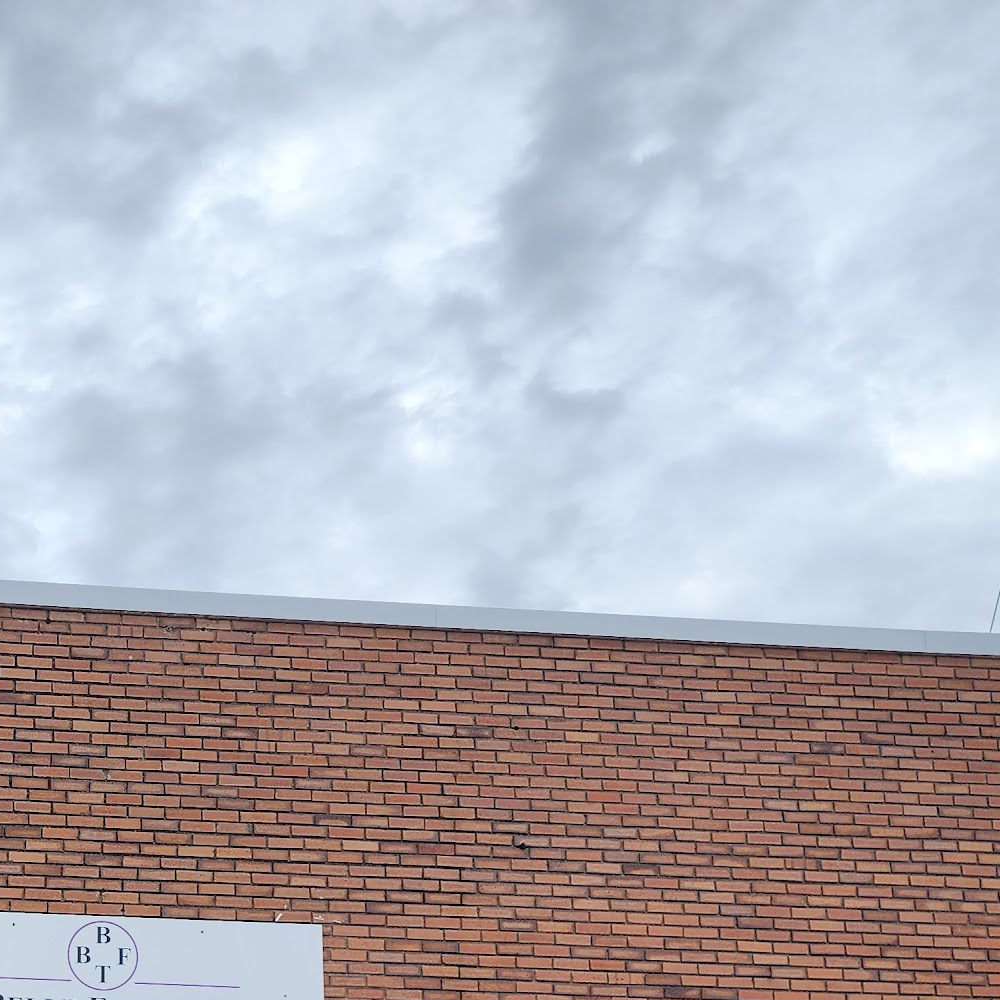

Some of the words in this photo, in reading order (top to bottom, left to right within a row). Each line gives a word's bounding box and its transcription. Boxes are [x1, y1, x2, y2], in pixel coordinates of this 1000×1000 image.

[96, 926, 111, 944] B
[76, 946, 91, 964] B
[117, 948, 131, 965] F
[95, 966, 110, 983] T
